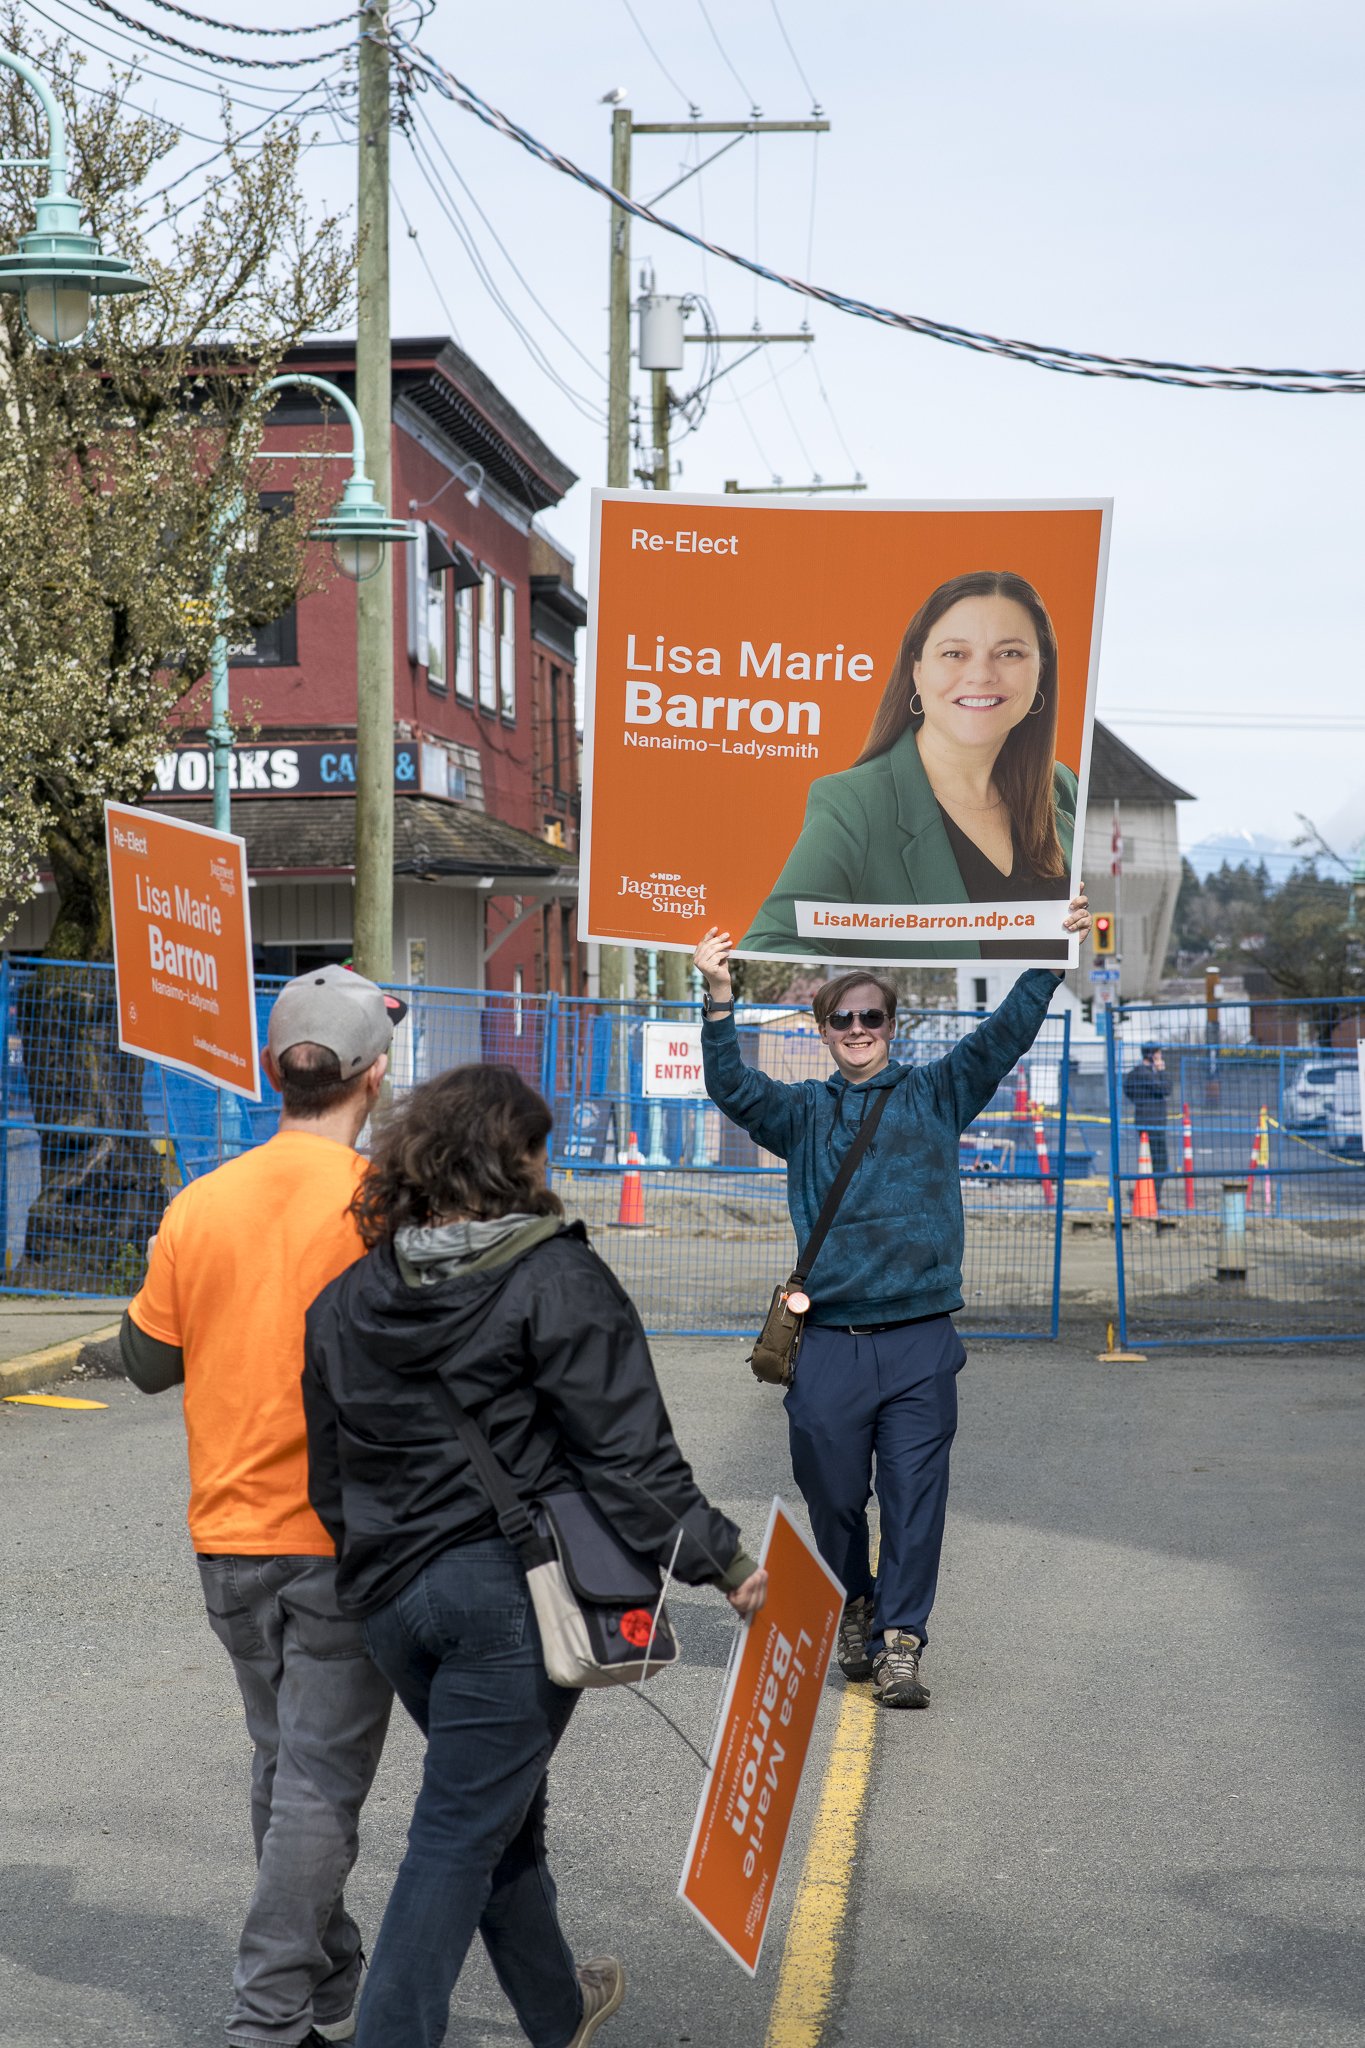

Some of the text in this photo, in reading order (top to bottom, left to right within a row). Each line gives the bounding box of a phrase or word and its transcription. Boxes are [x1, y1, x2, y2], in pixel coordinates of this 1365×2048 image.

[631, 528, 739, 555] Re-Elect
[626, 634, 874, 682] Lisa Marie
[624, 680, 821, 736] Barron
[395, 751, 415, 781] &
[113, 827, 148, 854] Re-Elect
[617, 875, 707, 900] Jagmeet
[657, 872, 681, 881] NDP
[135, 873, 222, 936] Lisa Marie
[652, 897, 706, 919] Singh
[813, 911, 1035, 931] LisaMarieBarron.ndp.ca
[148, 923, 218, 992] Barron
[668, 1041, 689, 1057] NO
[655, 1063, 701, 1080] ENTRY
[814, 1609, 834, 1679] Re-Elect
[731, 1631, 793, 1836] Barron
[742, 1628, 812, 1879] Lisa Marie
